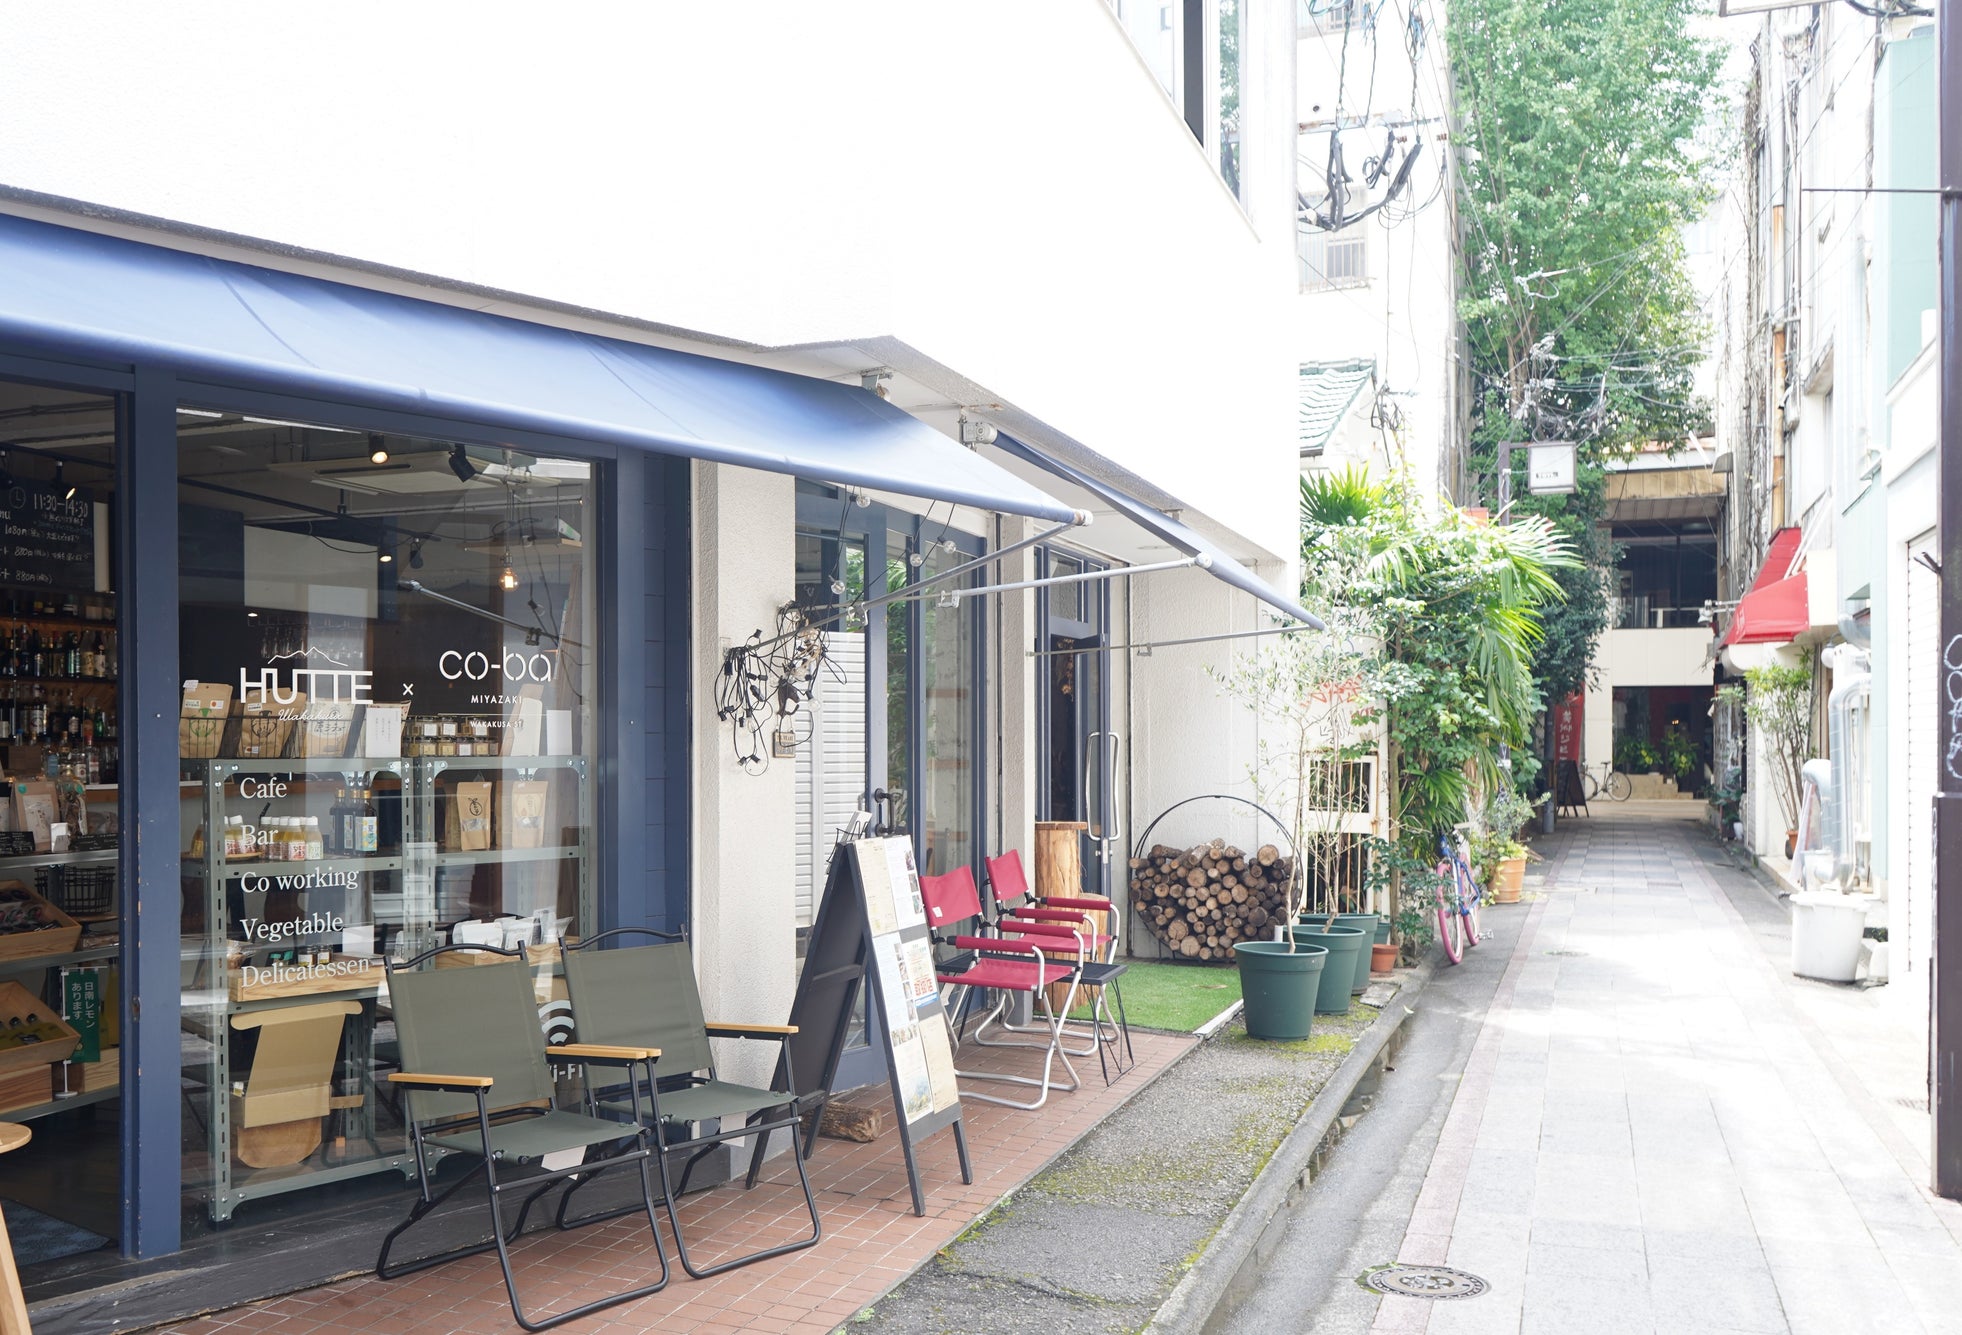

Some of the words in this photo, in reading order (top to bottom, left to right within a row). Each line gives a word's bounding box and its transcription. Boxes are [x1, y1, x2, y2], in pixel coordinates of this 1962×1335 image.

[240, 667, 373, 705] HUTTE
[471, 695, 522, 704] MIYAZAKI
[470, 720, 511, 728] WAKAKUSA
[241, 824, 278, 846] Bar
[241, 871, 270, 893] Co
[275, 866, 359, 890] working
[240, 911, 344, 942] Vegetable
[241, 958, 369, 988] Delicatessen
[71, 983, 82, 1020] あります
[84, 982, 95, 1028] 日南レモン
